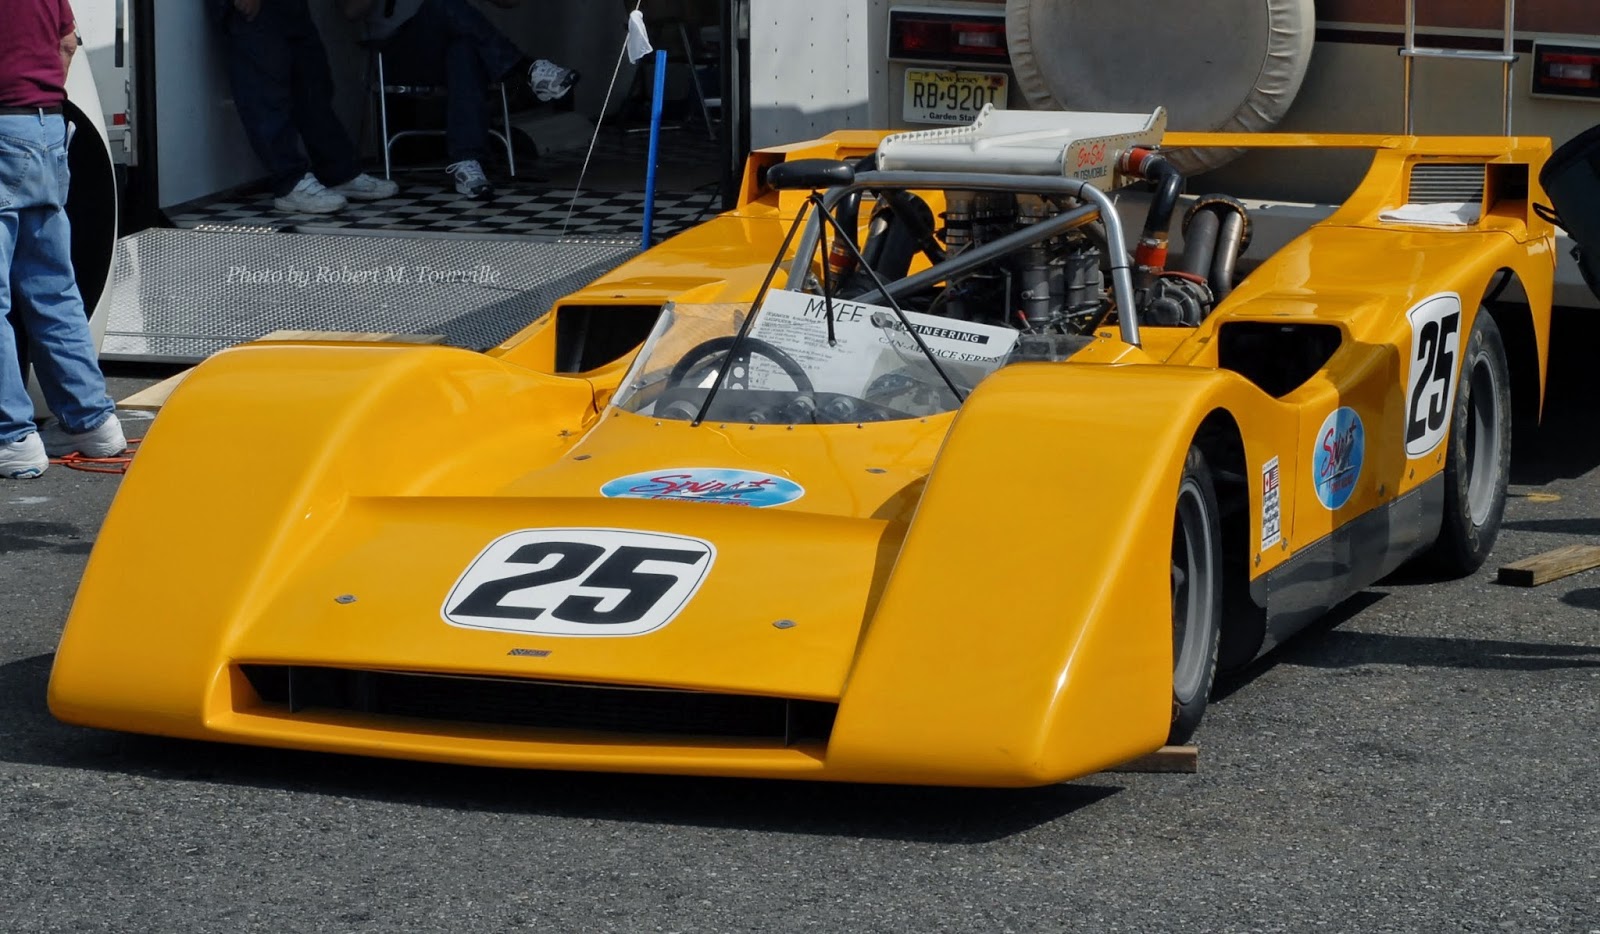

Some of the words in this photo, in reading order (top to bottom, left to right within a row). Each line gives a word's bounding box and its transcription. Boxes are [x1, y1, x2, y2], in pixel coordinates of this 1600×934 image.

[935, 73, 953, 83] New
[955, 74, 978, 84] Jersey
[929, 112, 957, 121] Garden
[1406, 312, 1460, 445] 25
[448, 540, 708, 625] 25
